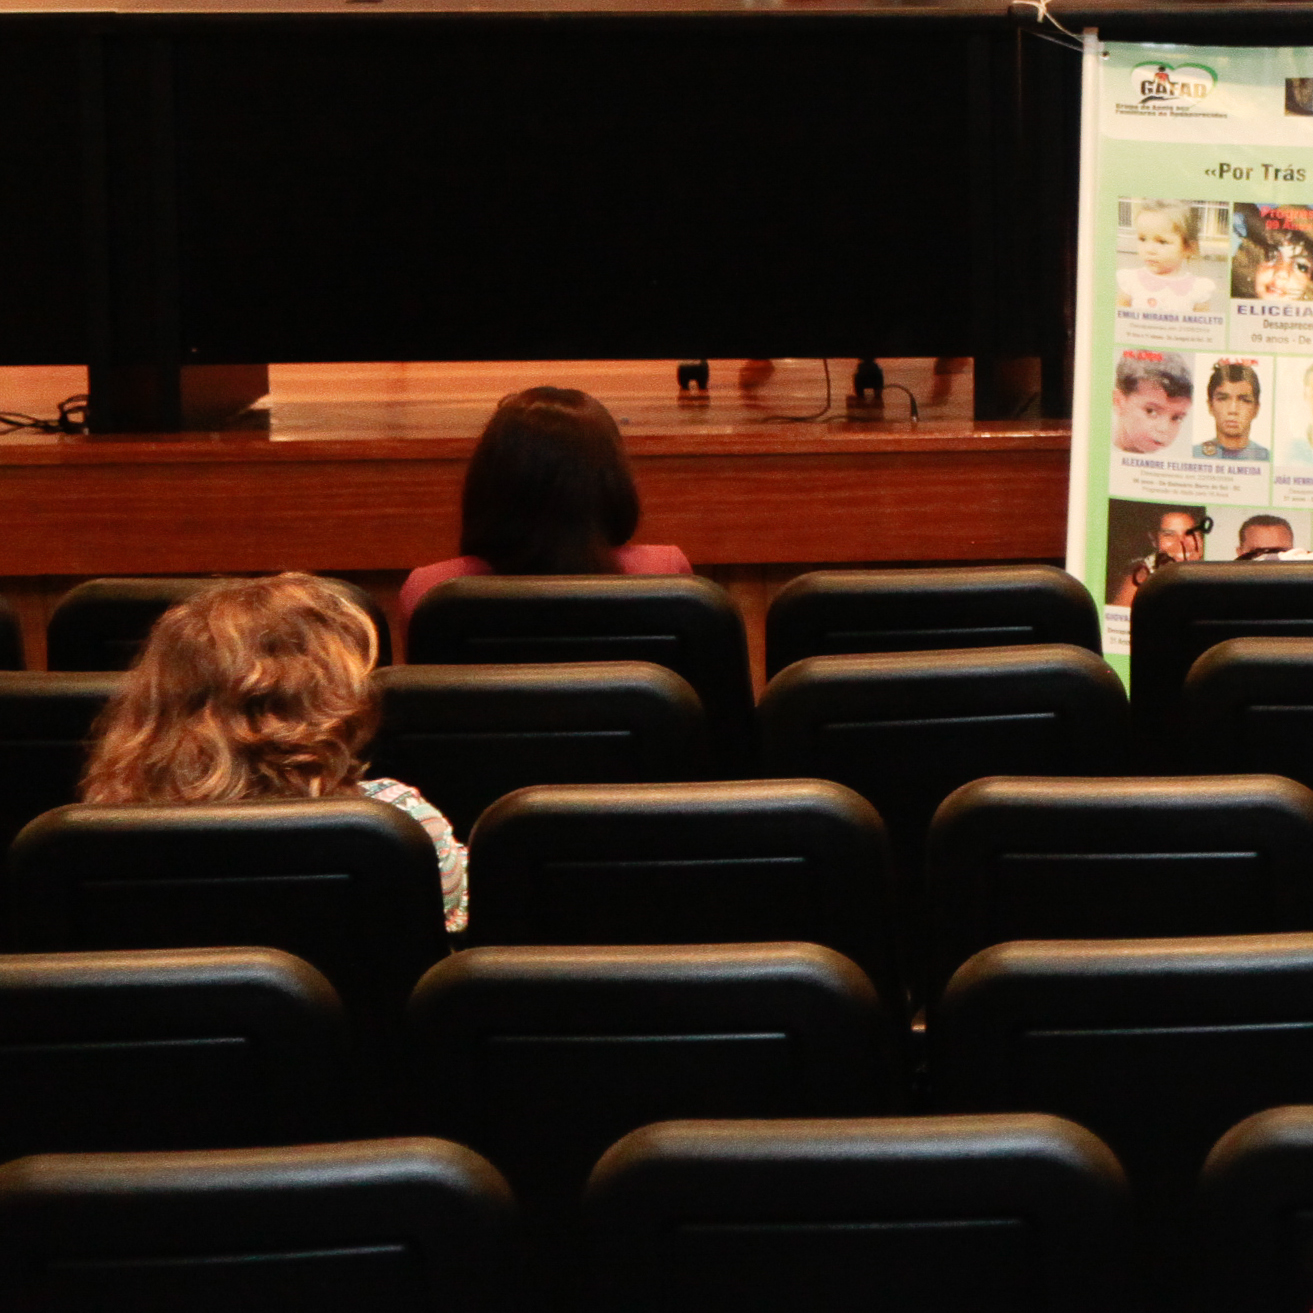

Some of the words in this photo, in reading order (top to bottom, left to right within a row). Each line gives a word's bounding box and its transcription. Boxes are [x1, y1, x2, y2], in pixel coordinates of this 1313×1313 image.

[1262, 163, 1306, 182] Trás
[1237, 304, 1313, 318] ELICÉIA
[1142, 312, 1179, 322] MIRANDA
[1183, 316, 1223, 325] ANACLETO
[1265, 336, 1290, 344] anos
[1299, 335, 1312, 344] De
[1122, 457, 1164, 470] ALEXANDRE
[1167, 462, 1212, 473] FELISBERTO
[1216, 465, 1224, 474] DE
[1228, 466, 1261, 475] ALMEIDA
